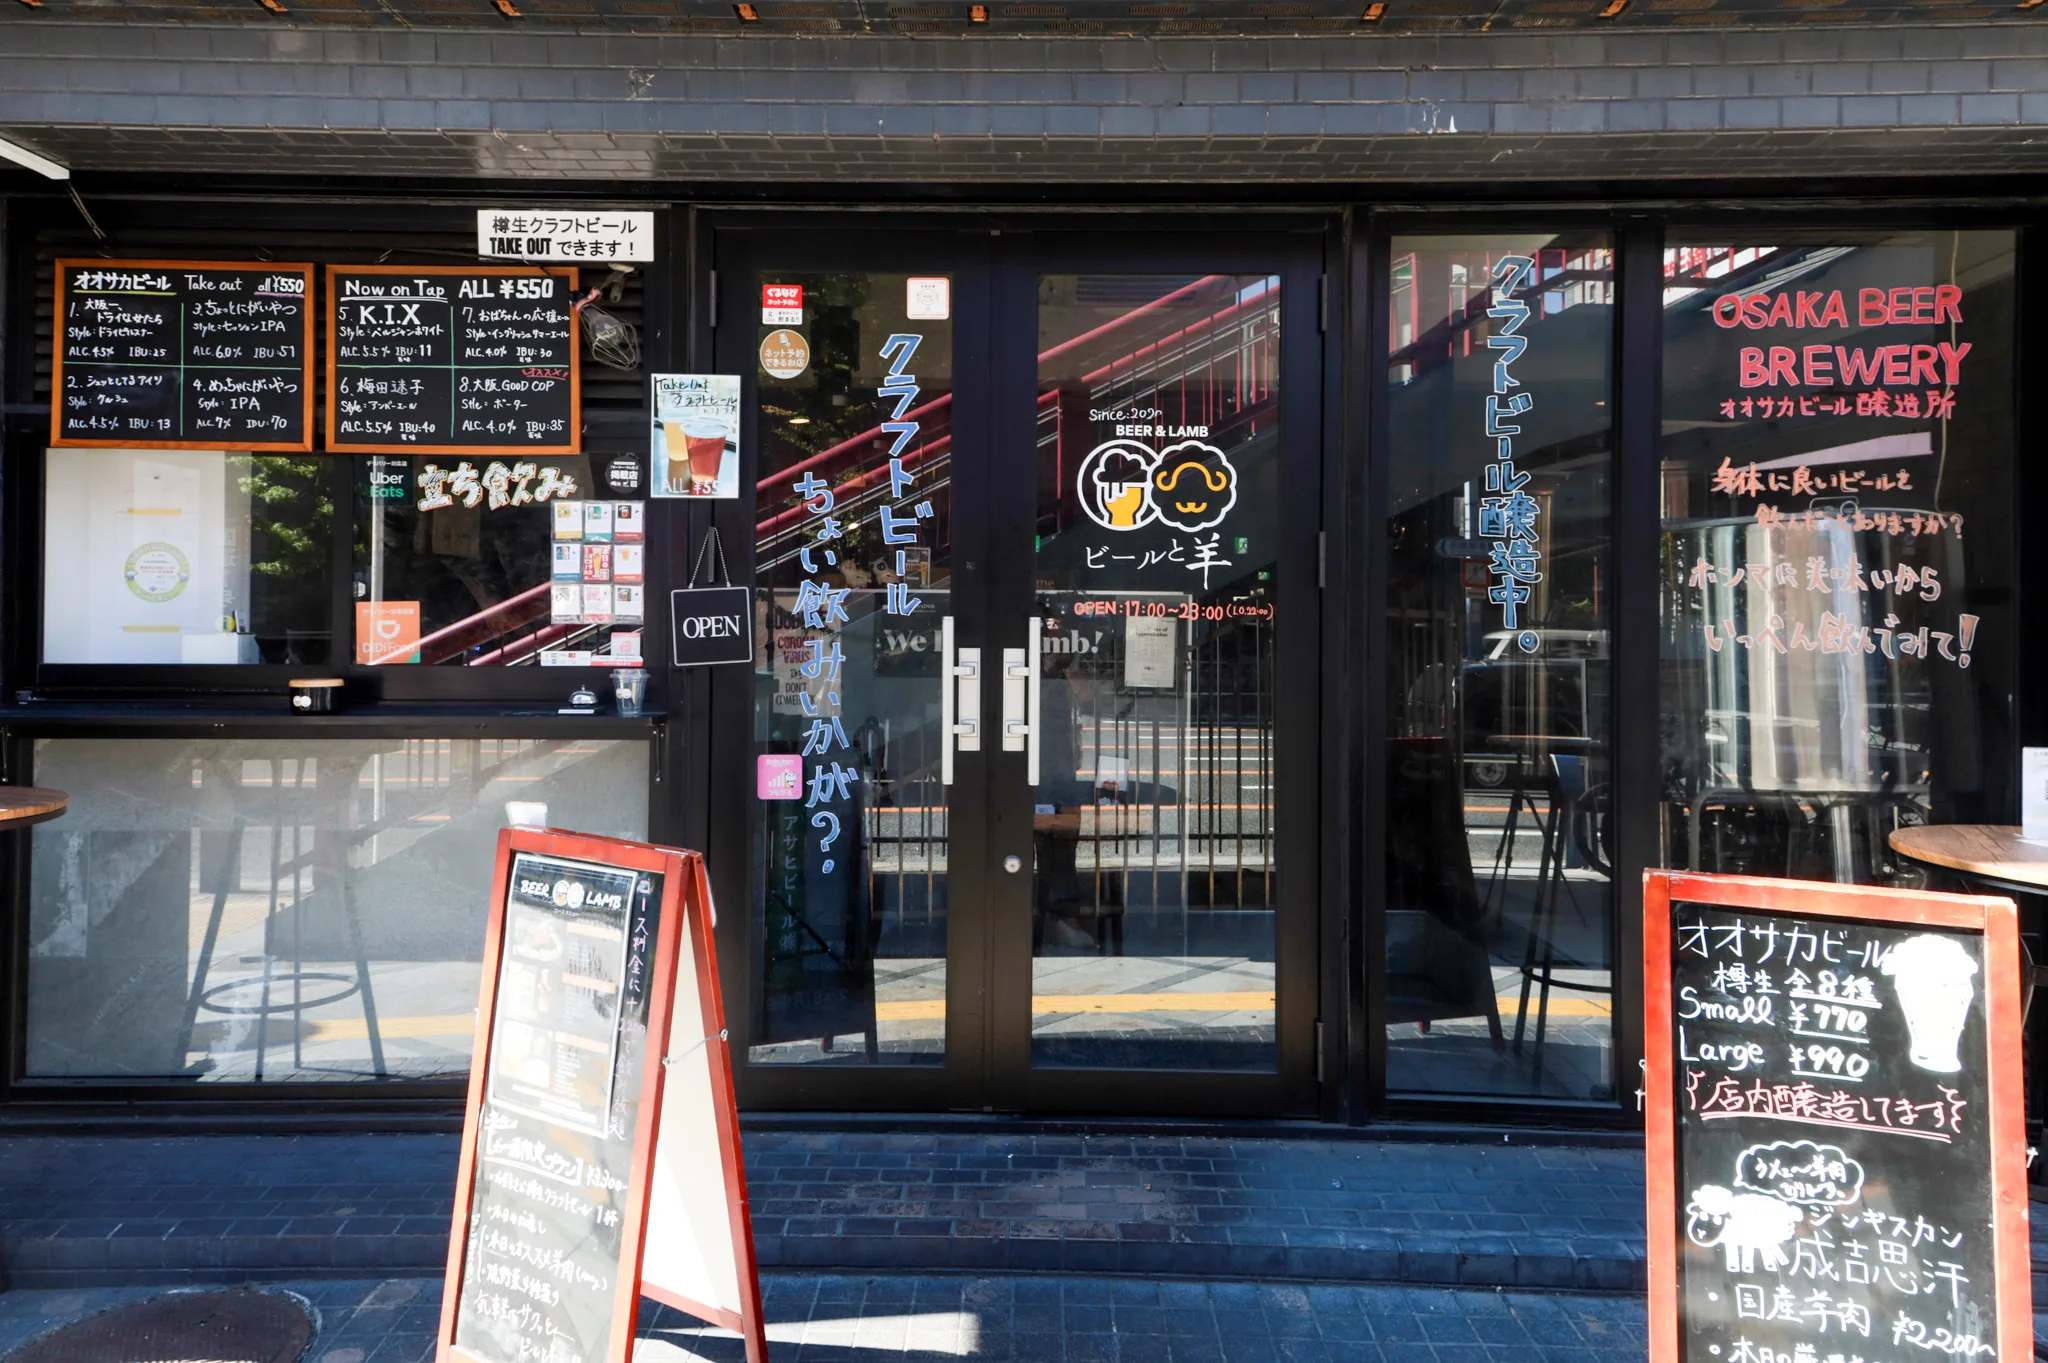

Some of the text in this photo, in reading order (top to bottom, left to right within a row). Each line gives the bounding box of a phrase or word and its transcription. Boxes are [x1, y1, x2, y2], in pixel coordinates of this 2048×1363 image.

[492, 216, 637, 234] 樽生クラフトビール
[490, 237, 522, 255] TAKE
[527, 238, 551, 255] OUT
[74, 271, 172, 290] オオサカビール
[184, 274, 216, 290] Take
[220, 278, 243, 290] out
[345, 280, 445, 298] Now on Tap
[458, 279, 554, 299] ALL ¥550
[360, 304, 421, 325] K.I.X
[1712, 284, 1963, 329] OSAKA BEER
[765, 349, 804, 358] ネット予約
[1740, 342, 1972, 388] BREWERY
[230, 397, 260, 410] IPA
[1719, 388, 1956, 420] オオサカビール醸造所
[1116, 425, 1209, 438] BEER & LAMB
[370, 472, 404, 484] Uber
[877, 333, 934, 616] クラフトビール
[370, 485, 404, 497] Eats
[417, 460, 578, 512] 立ち飲み
[1086, 532, 1232, 590] ビールと羊
[682, 615, 740, 638] OPEN
[884, 629, 927, 652] We
[520, 880, 622, 909] BEER LAMB
[1678, 986, 1776, 1026] Small
[1679, 1026, 1766, 1072] Large
[1788, 1230, 1970, 1310] 成吉思汗
